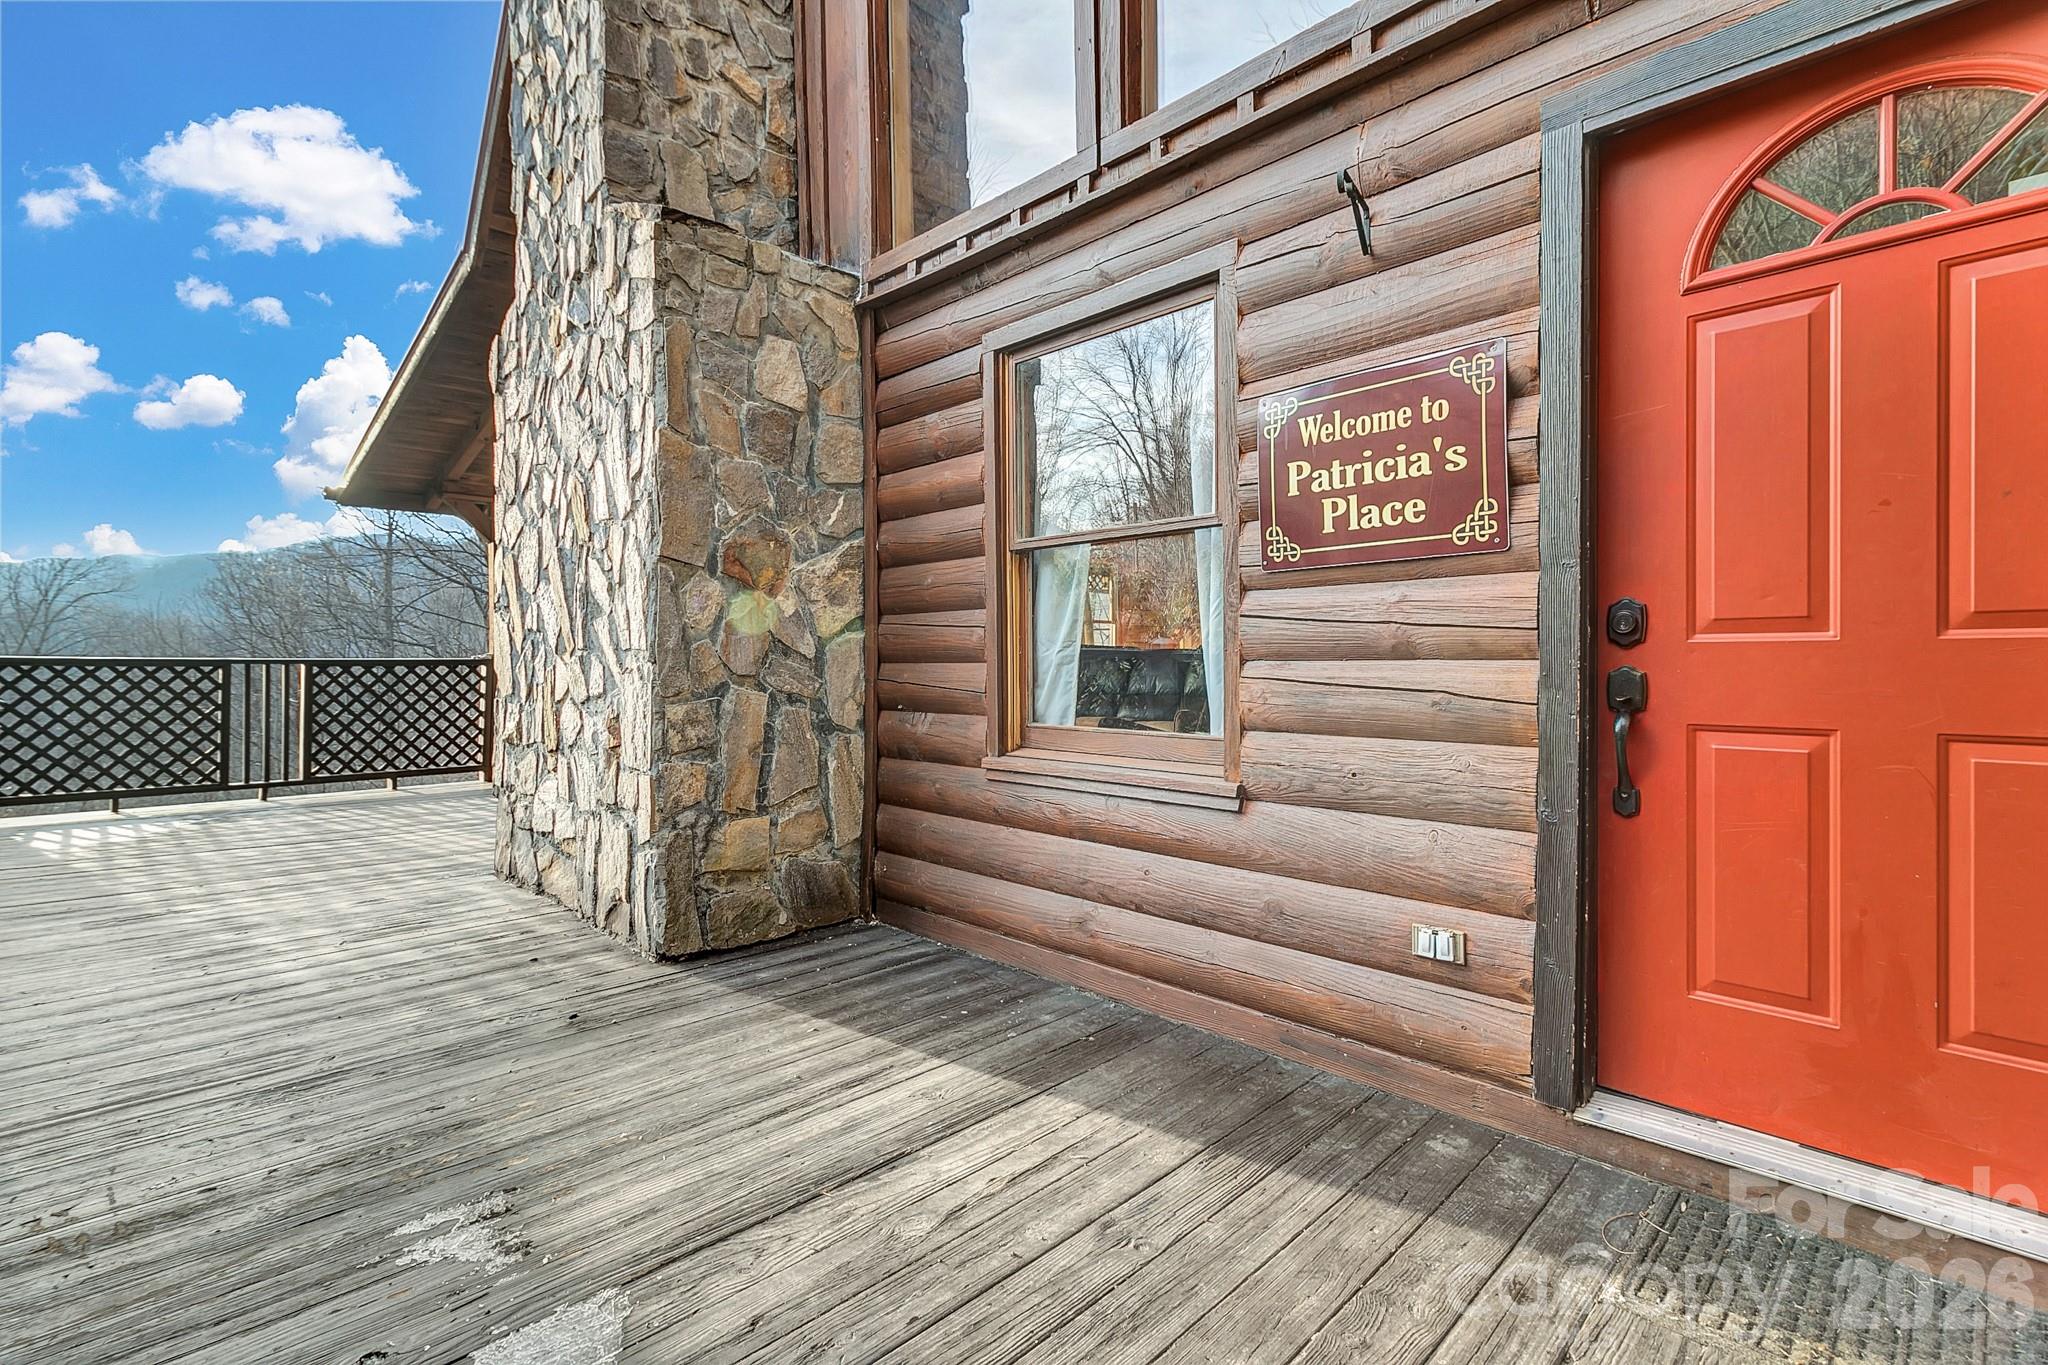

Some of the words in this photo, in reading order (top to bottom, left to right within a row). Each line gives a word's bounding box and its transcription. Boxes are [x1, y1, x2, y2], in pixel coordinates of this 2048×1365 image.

[1297, 405, 1412, 447] Welcome
[1420, 395, 1450, 424] to
[1287, 437, 1468, 497] Patricia's
[1321, 494, 1427, 534] Place
